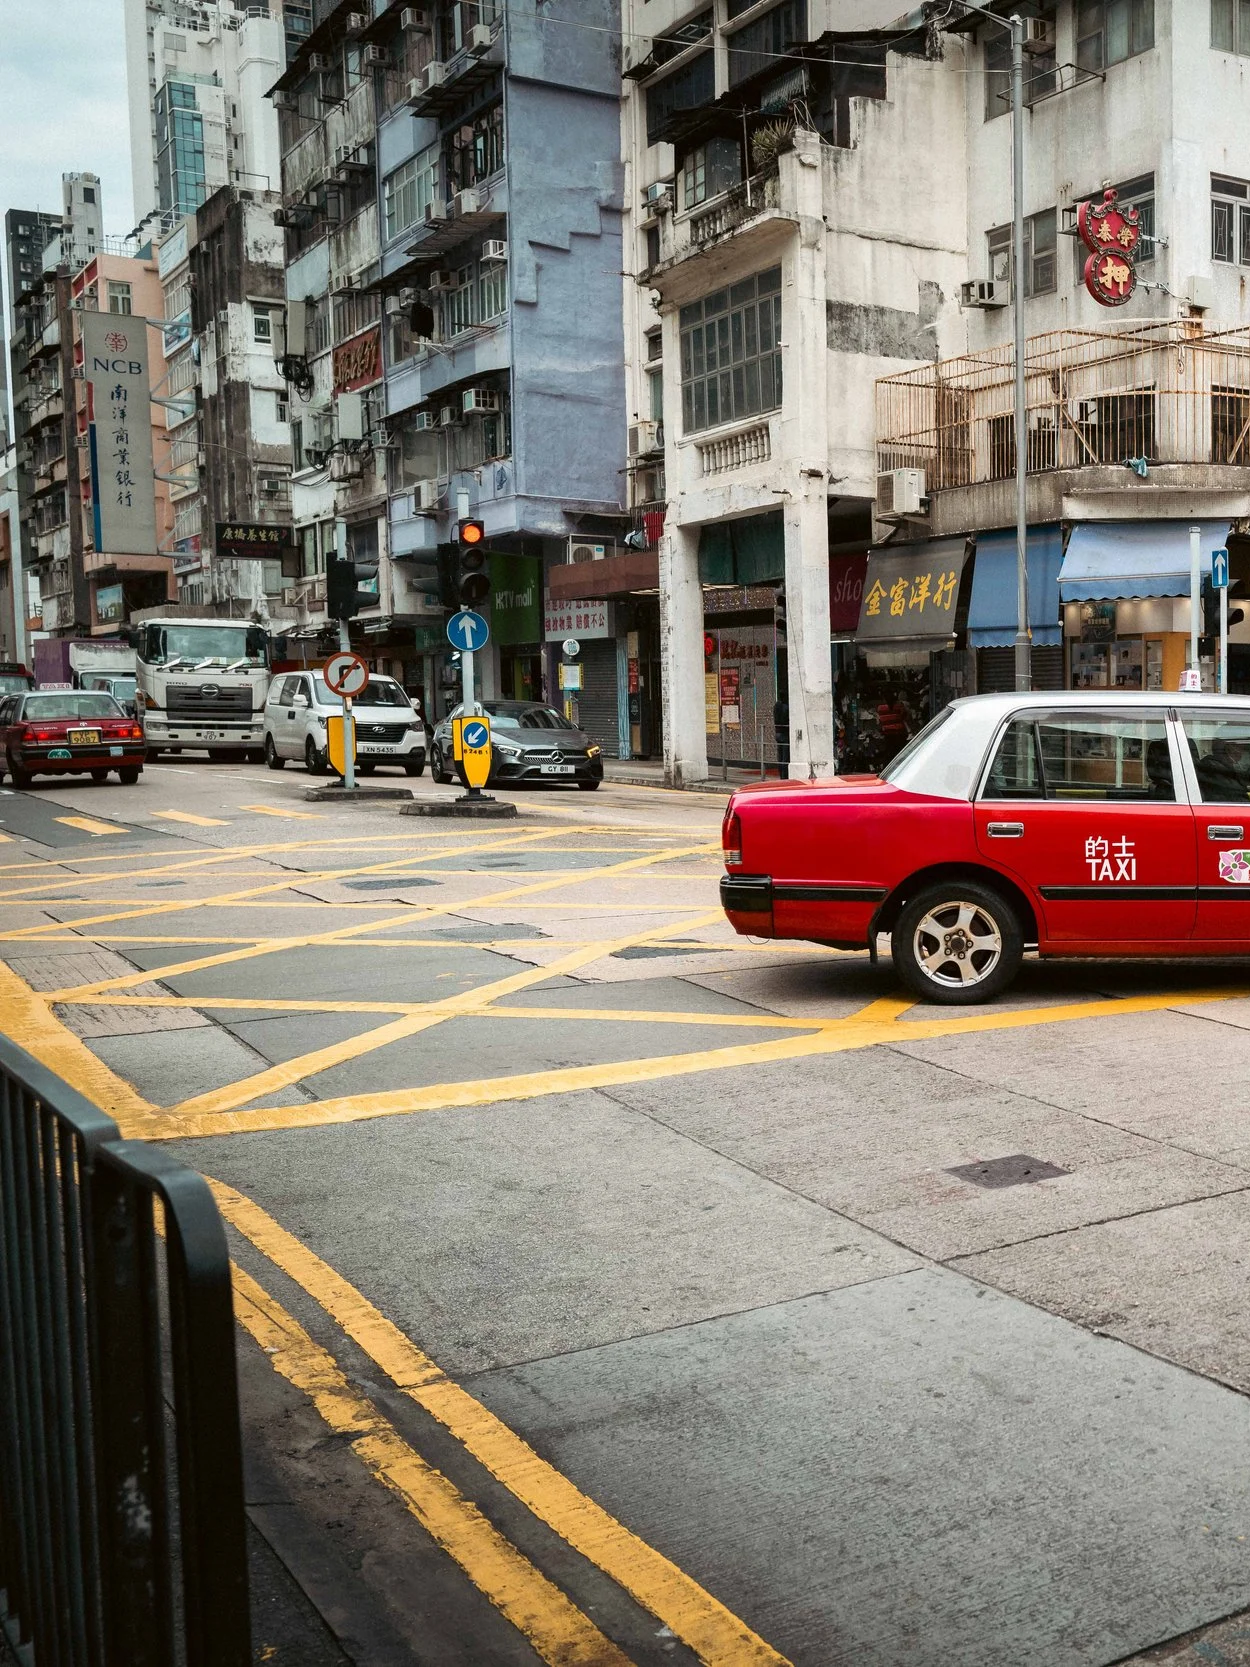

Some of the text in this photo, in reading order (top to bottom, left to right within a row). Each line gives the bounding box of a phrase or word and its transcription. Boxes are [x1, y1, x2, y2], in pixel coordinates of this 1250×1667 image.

[1099, 256, 1131, 295] 押
[93, 358, 142, 375] NCB
[110, 383, 136, 508] 南洋商業銀行
[864, 570, 958, 616] 金富洋行
[1085, 835, 1135, 857] 的士
[1085, 858, 1136, 881] TAXI
